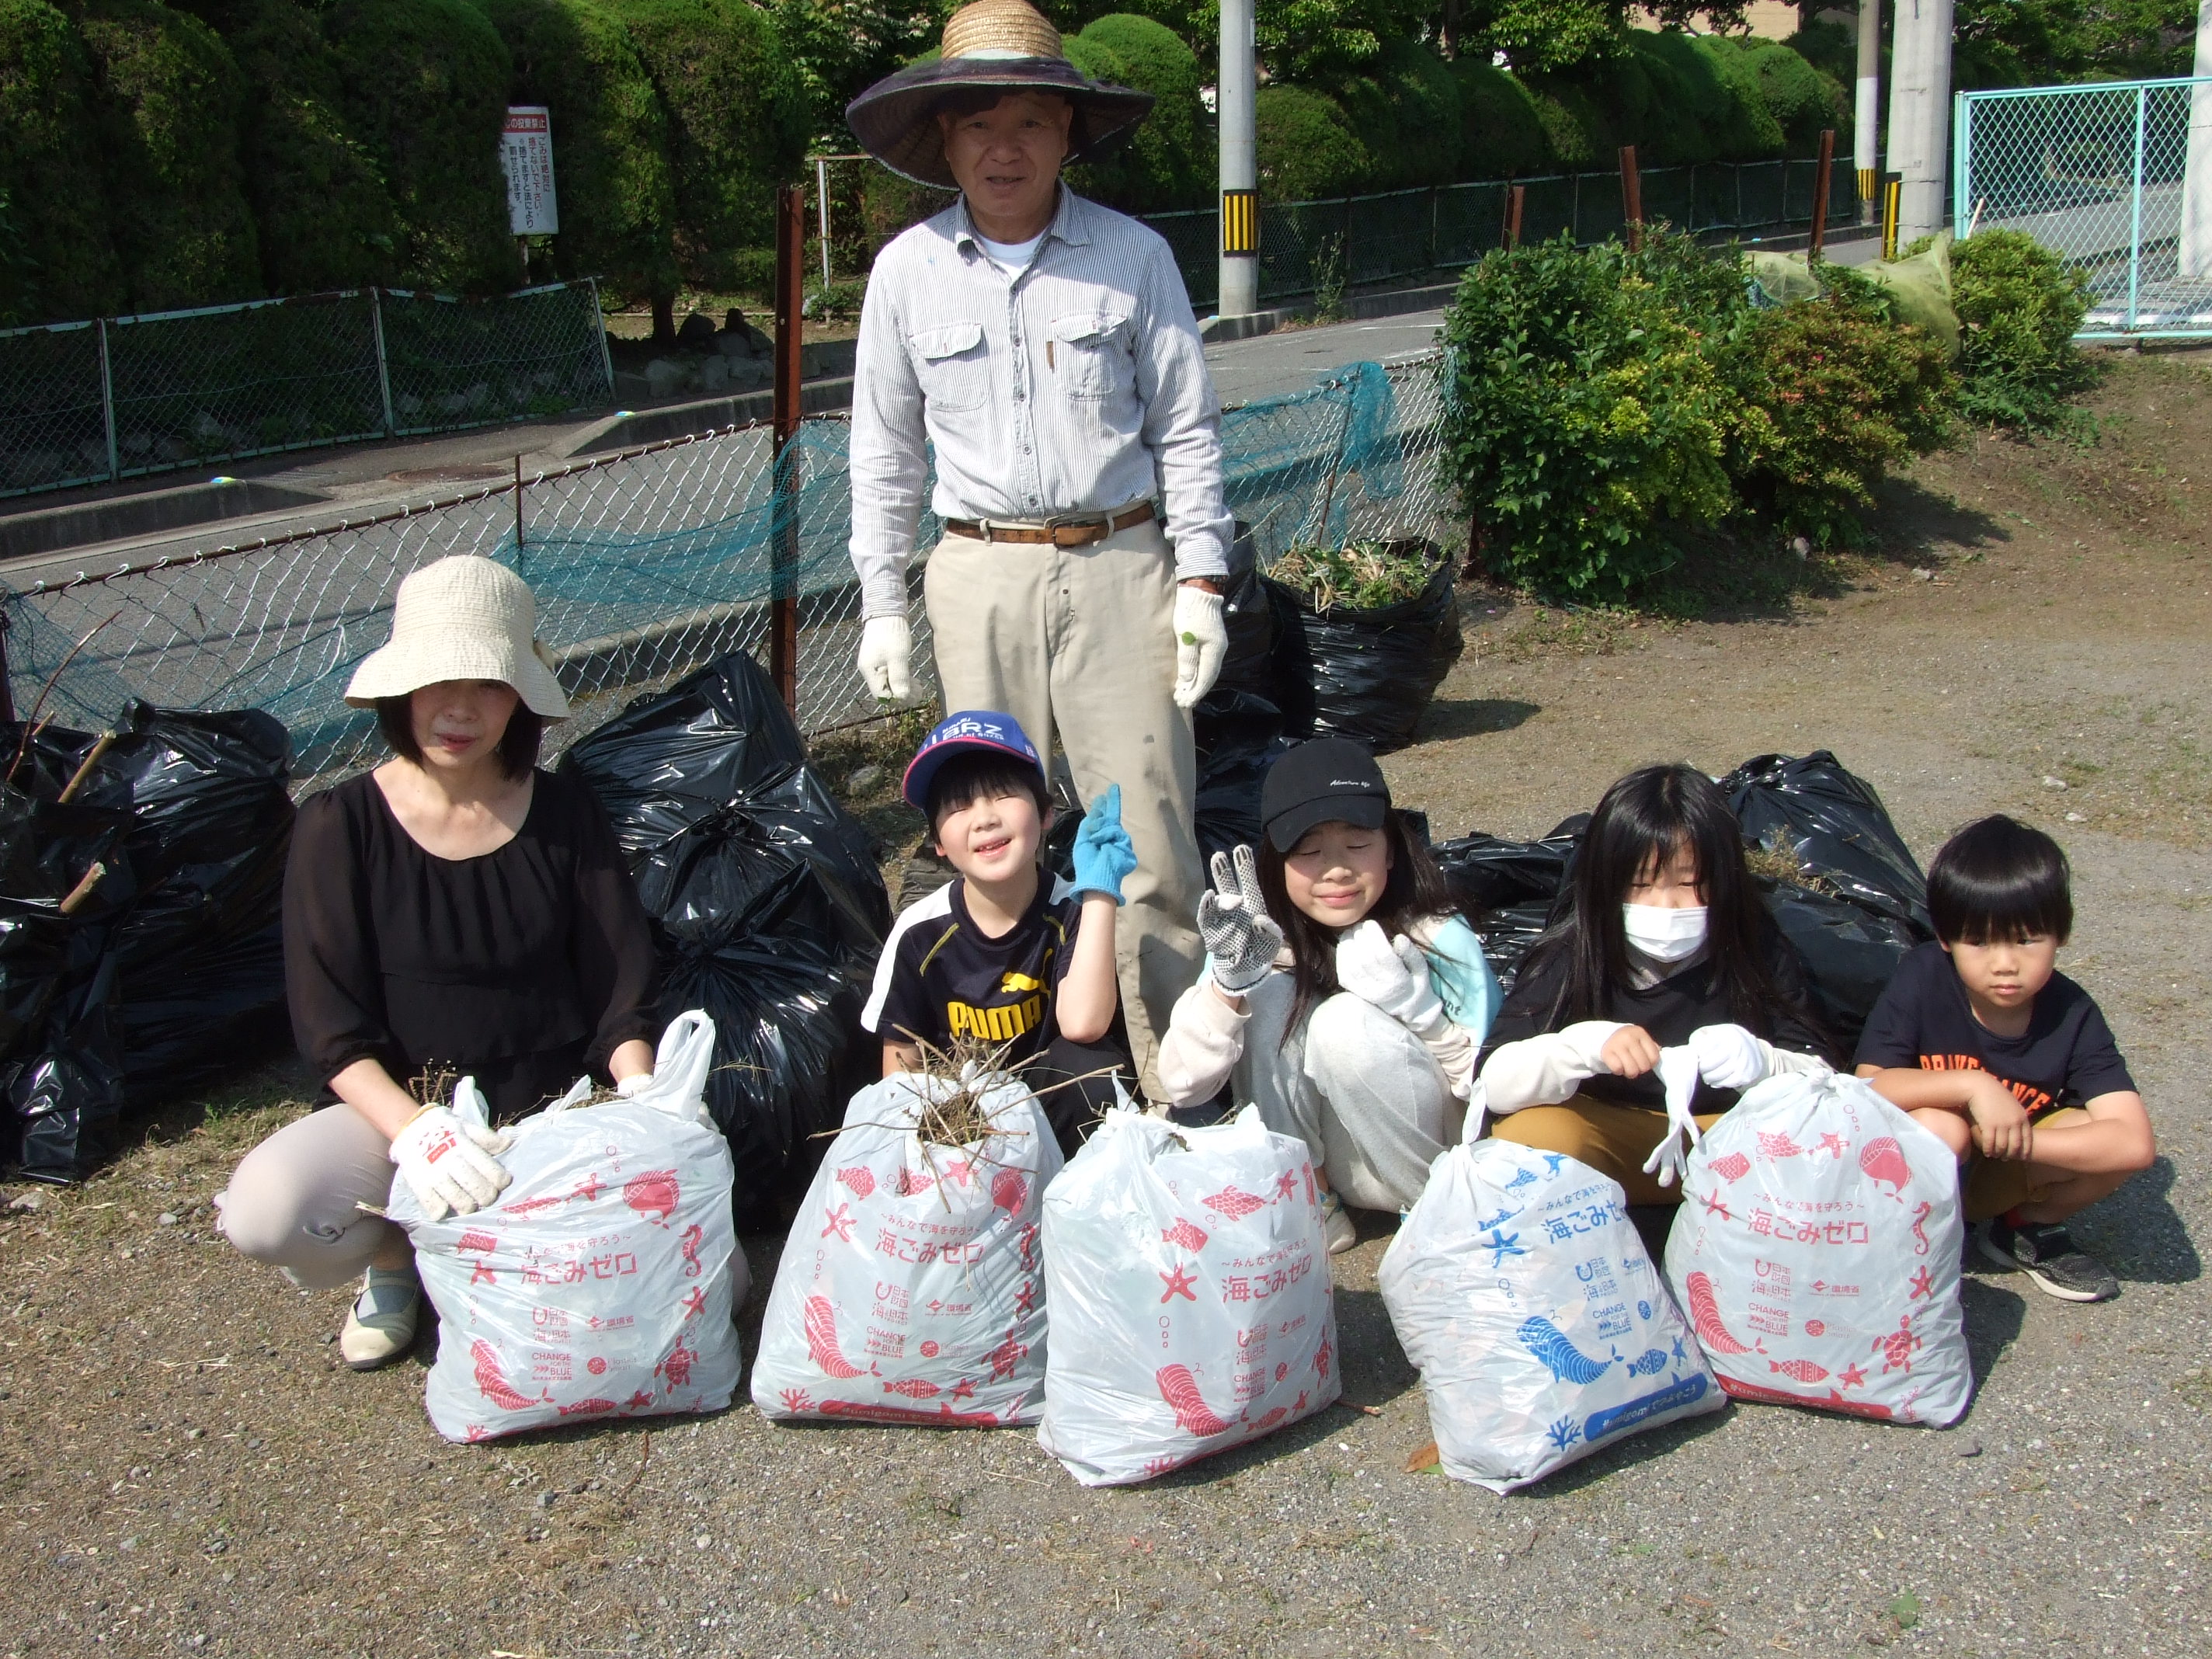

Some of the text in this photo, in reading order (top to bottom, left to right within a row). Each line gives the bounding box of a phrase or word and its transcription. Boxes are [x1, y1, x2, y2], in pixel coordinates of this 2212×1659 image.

[948, 994, 1042, 1041] PUMA
[1748, 1207, 1869, 1245] 海ごみゼロ
[875, 1227, 985, 1264] 海ごみゼロ
[1221, 1253, 1313, 1303] 海ごみゼロ
[1592, 1303, 1626, 1319] CHANGE
[1748, 1303, 1789, 1319] CHANGE
[1612, 1316, 1632, 1330] BLUE
[1765, 1320, 1788, 1332] BLUE
[867, 1325, 906, 1342] CHANGE
[532, 1352, 572, 1361] CHANGE
[882, 1344, 905, 1355] BLUE
